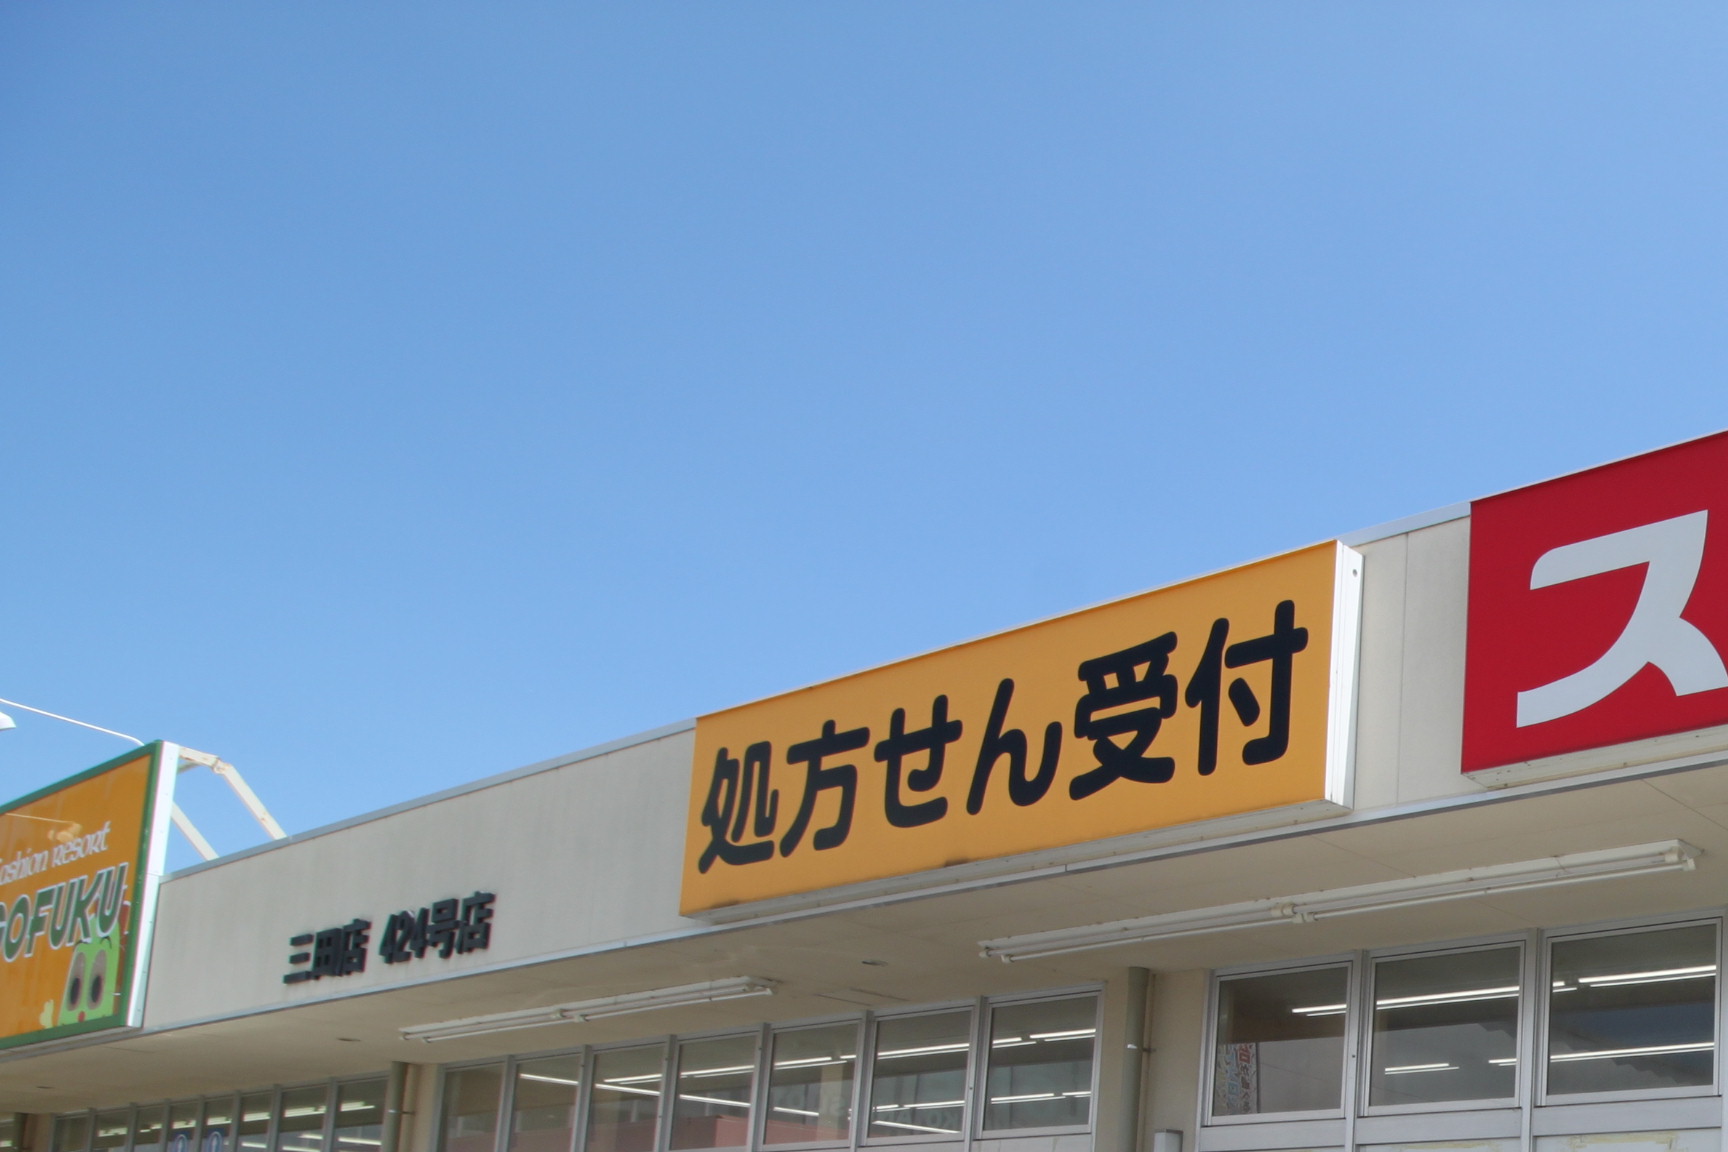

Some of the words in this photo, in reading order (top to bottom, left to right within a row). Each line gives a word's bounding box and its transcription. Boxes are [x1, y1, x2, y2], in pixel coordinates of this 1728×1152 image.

[698, 599, 1309, 875] 処方せん受付
[0, 846, 49, 886] ashion
[0, 862, 129, 963] OFUKU
[283, 918, 372, 984] 三田店
[379, 891, 497, 964] 424号店
